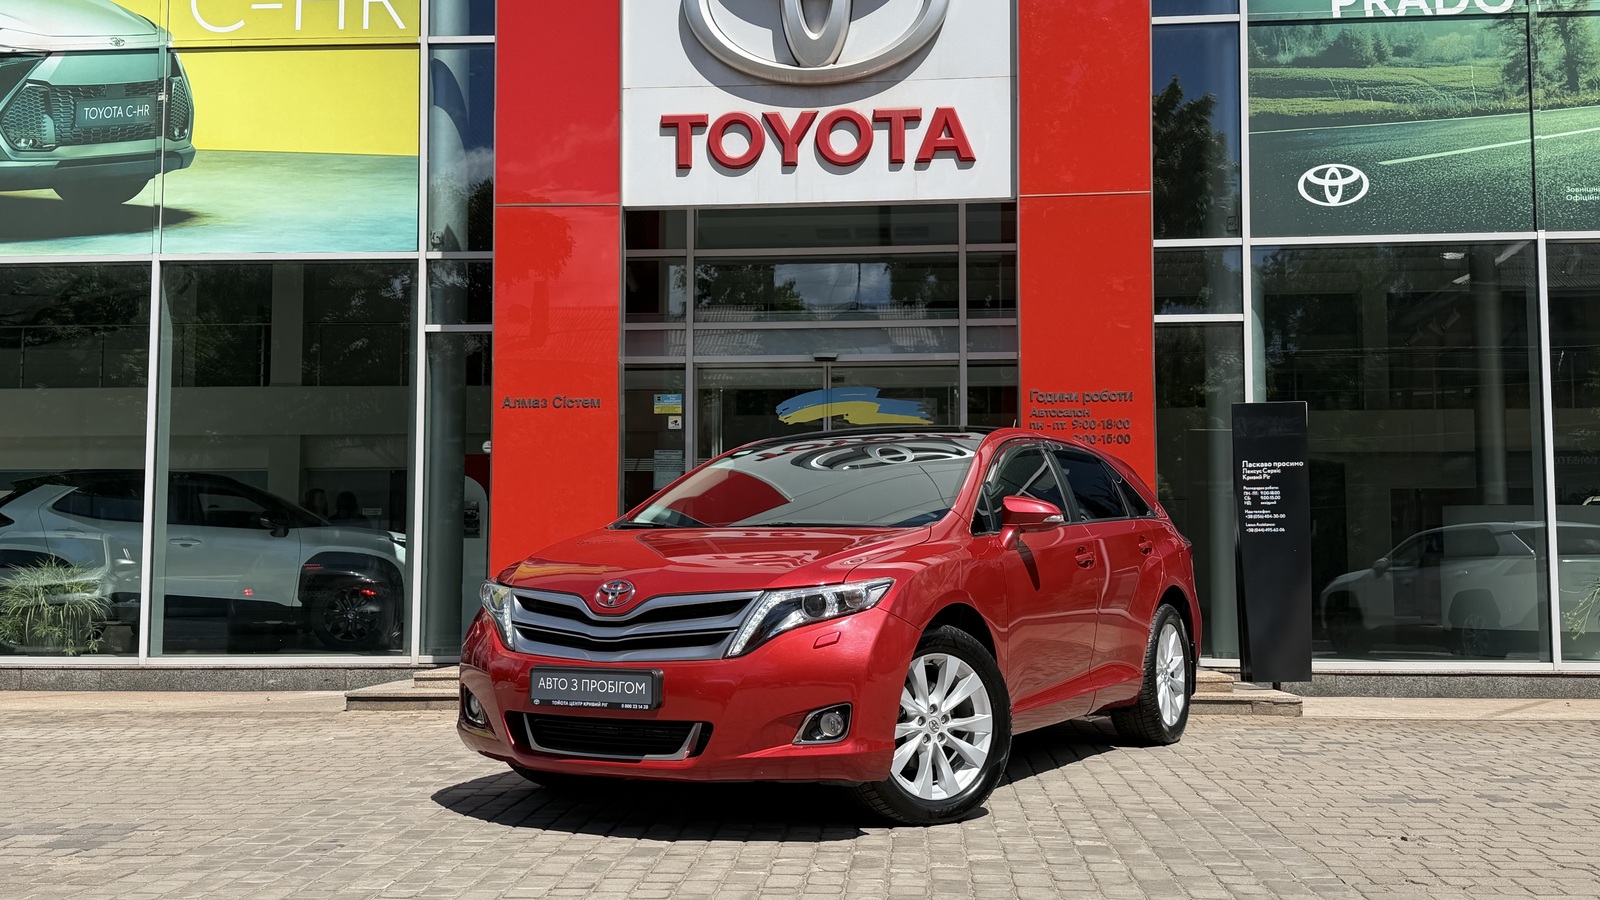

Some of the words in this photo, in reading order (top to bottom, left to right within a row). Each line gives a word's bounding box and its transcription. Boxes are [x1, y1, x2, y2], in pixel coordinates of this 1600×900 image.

[83, 105, 124, 120] TOYOTA
[125, 104, 150, 117] C-HR
[660, 106, 977, 171] TOYOTA
[501, 395, 548, 409] Алмаз
[552, 394, 601, 409] Сістем
[1029, 389, 1079, 404] Години
[1083, 389, 1133, 405] роботи
[1029, 407, 1091, 418] Автосалон
[1029, 421, 1044, 430] пн
[1071, 418, 1131, 430] 9:00-18:00
[537, 676, 568, 691] АВТО
[571, 678, 578, 691] З
[581, 679, 646, 695] ПРОБІГОМ
